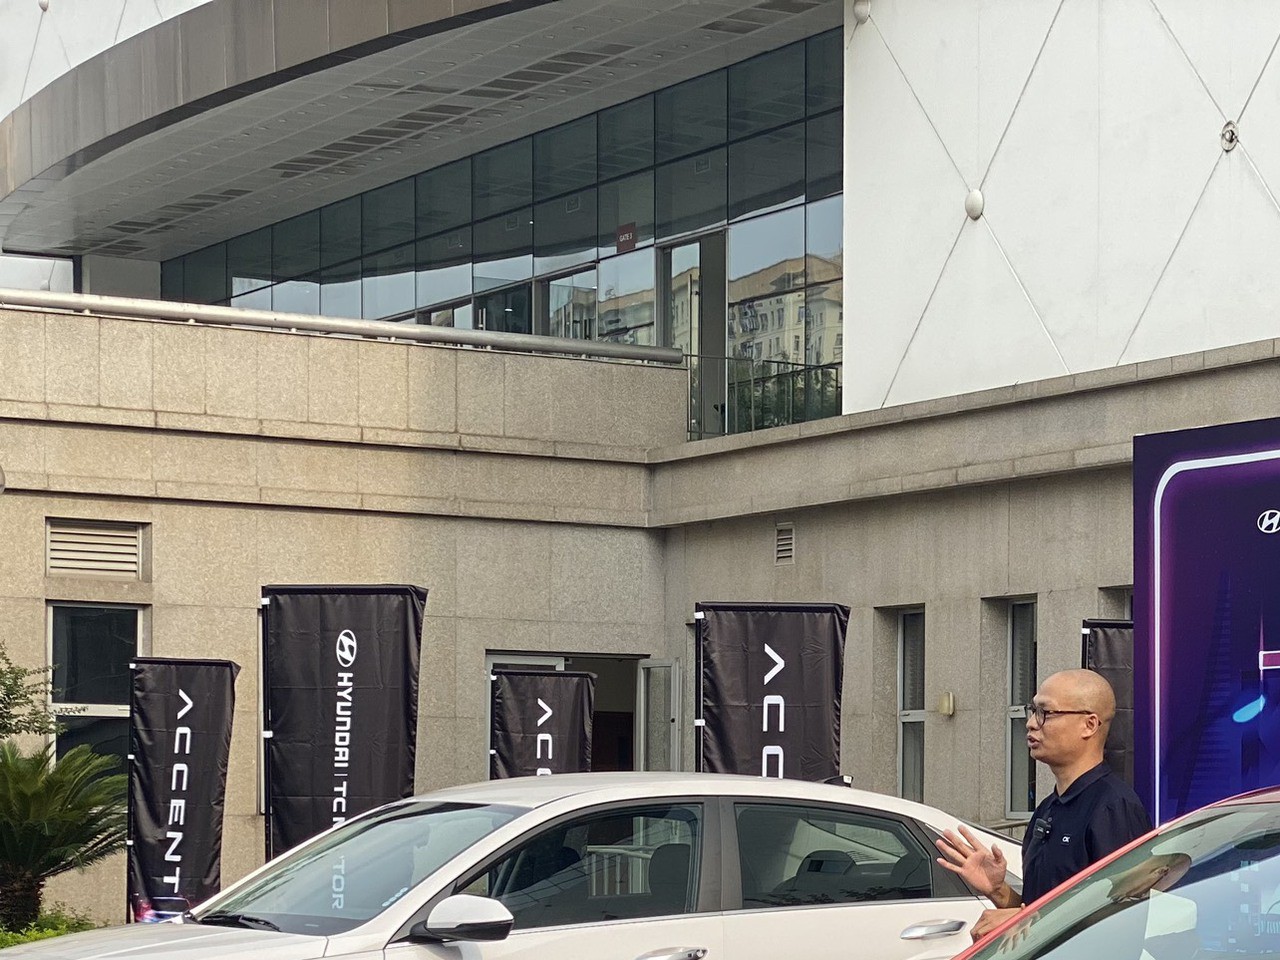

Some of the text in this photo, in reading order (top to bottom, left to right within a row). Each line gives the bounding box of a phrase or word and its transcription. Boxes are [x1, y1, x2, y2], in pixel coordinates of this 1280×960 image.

[619, 234, 630, 242] GATE
[333, 672, 354, 768] HYUNDAI
[762, 643, 786, 780] ACC
[162, 688, 194, 894] ACCENT
[332, 781, 348, 813] TC
